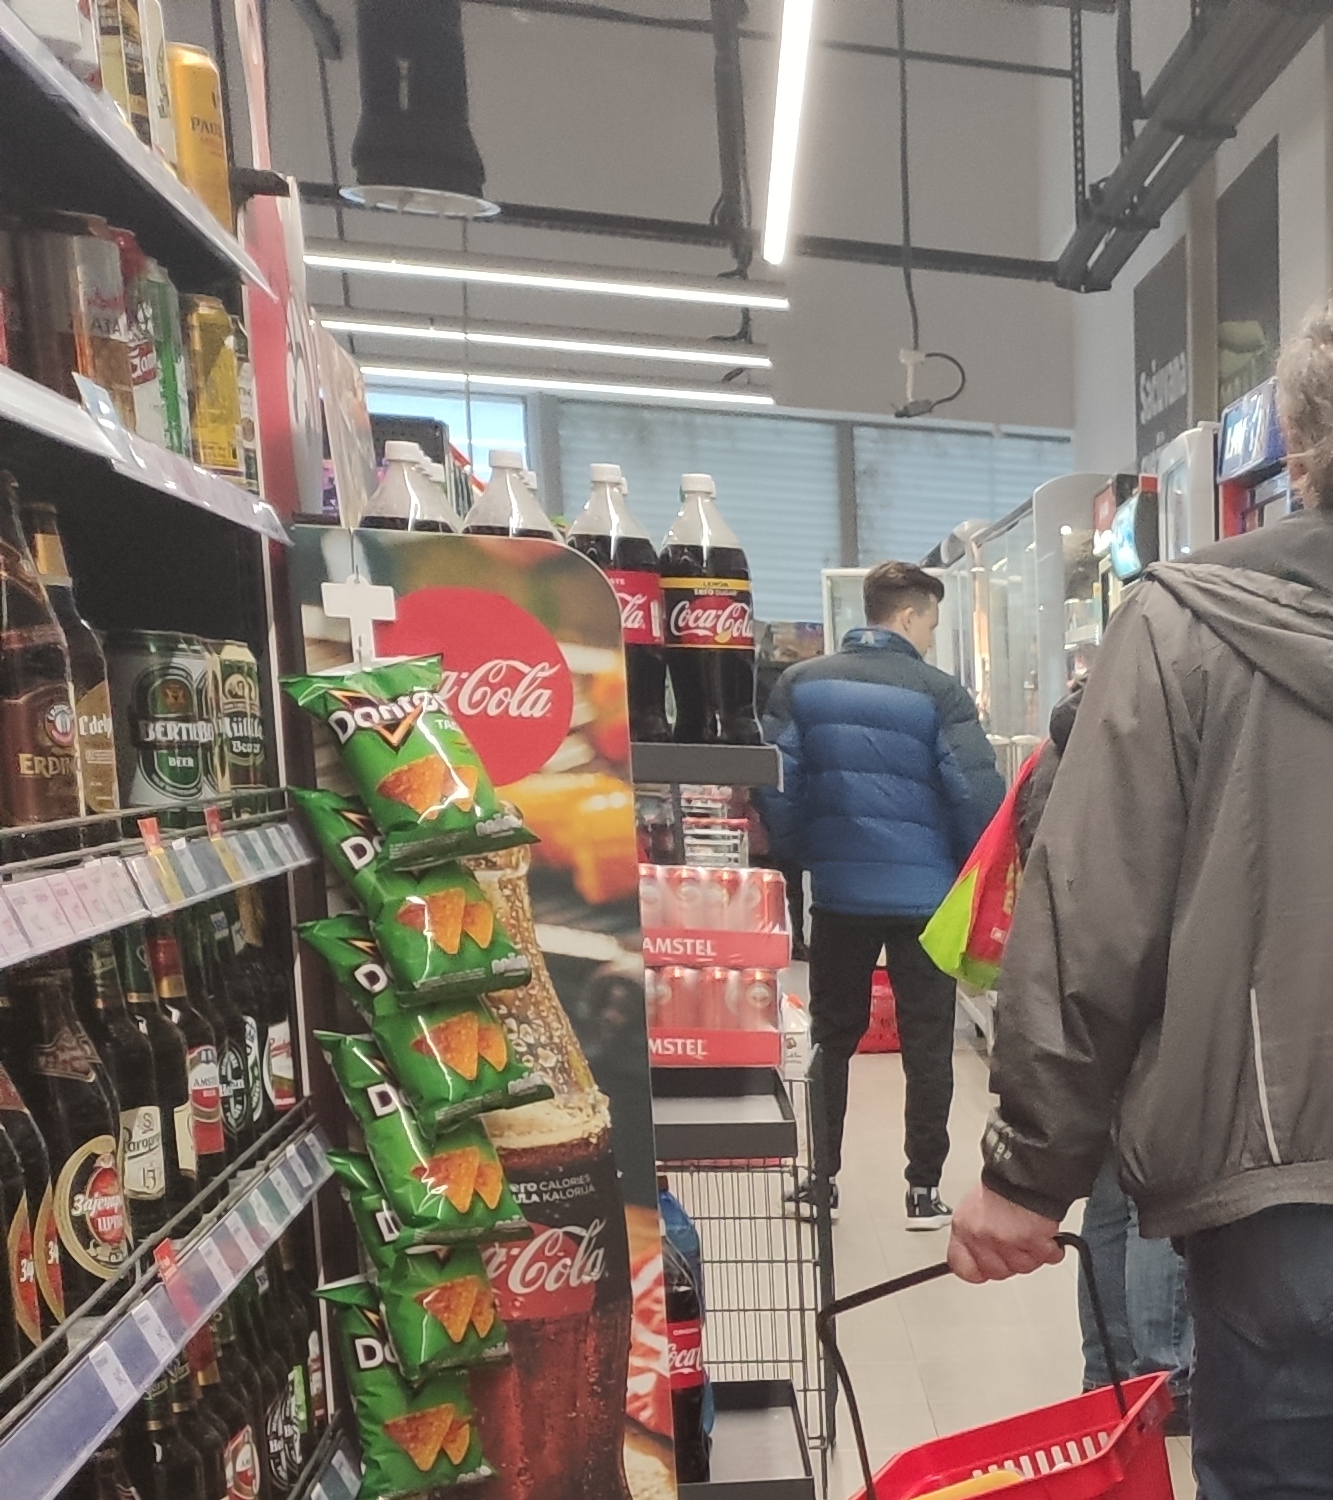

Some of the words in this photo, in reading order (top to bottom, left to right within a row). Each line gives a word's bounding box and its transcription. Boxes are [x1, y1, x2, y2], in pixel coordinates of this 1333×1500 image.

[670, 600, 754, 638] Coca-Col
[440, 658, 562, 720] a-Cola
[642, 937, 717, 957] AMSTEL
[648, 1037, 709, 1059] MSTEL
[539, 1173, 592, 1191] CALORIES
[513, 1193, 541, 1205] ULA
[542, 1183, 596, 1203] KALORIJA
[485, 1217, 607, 1295] a-Cola
